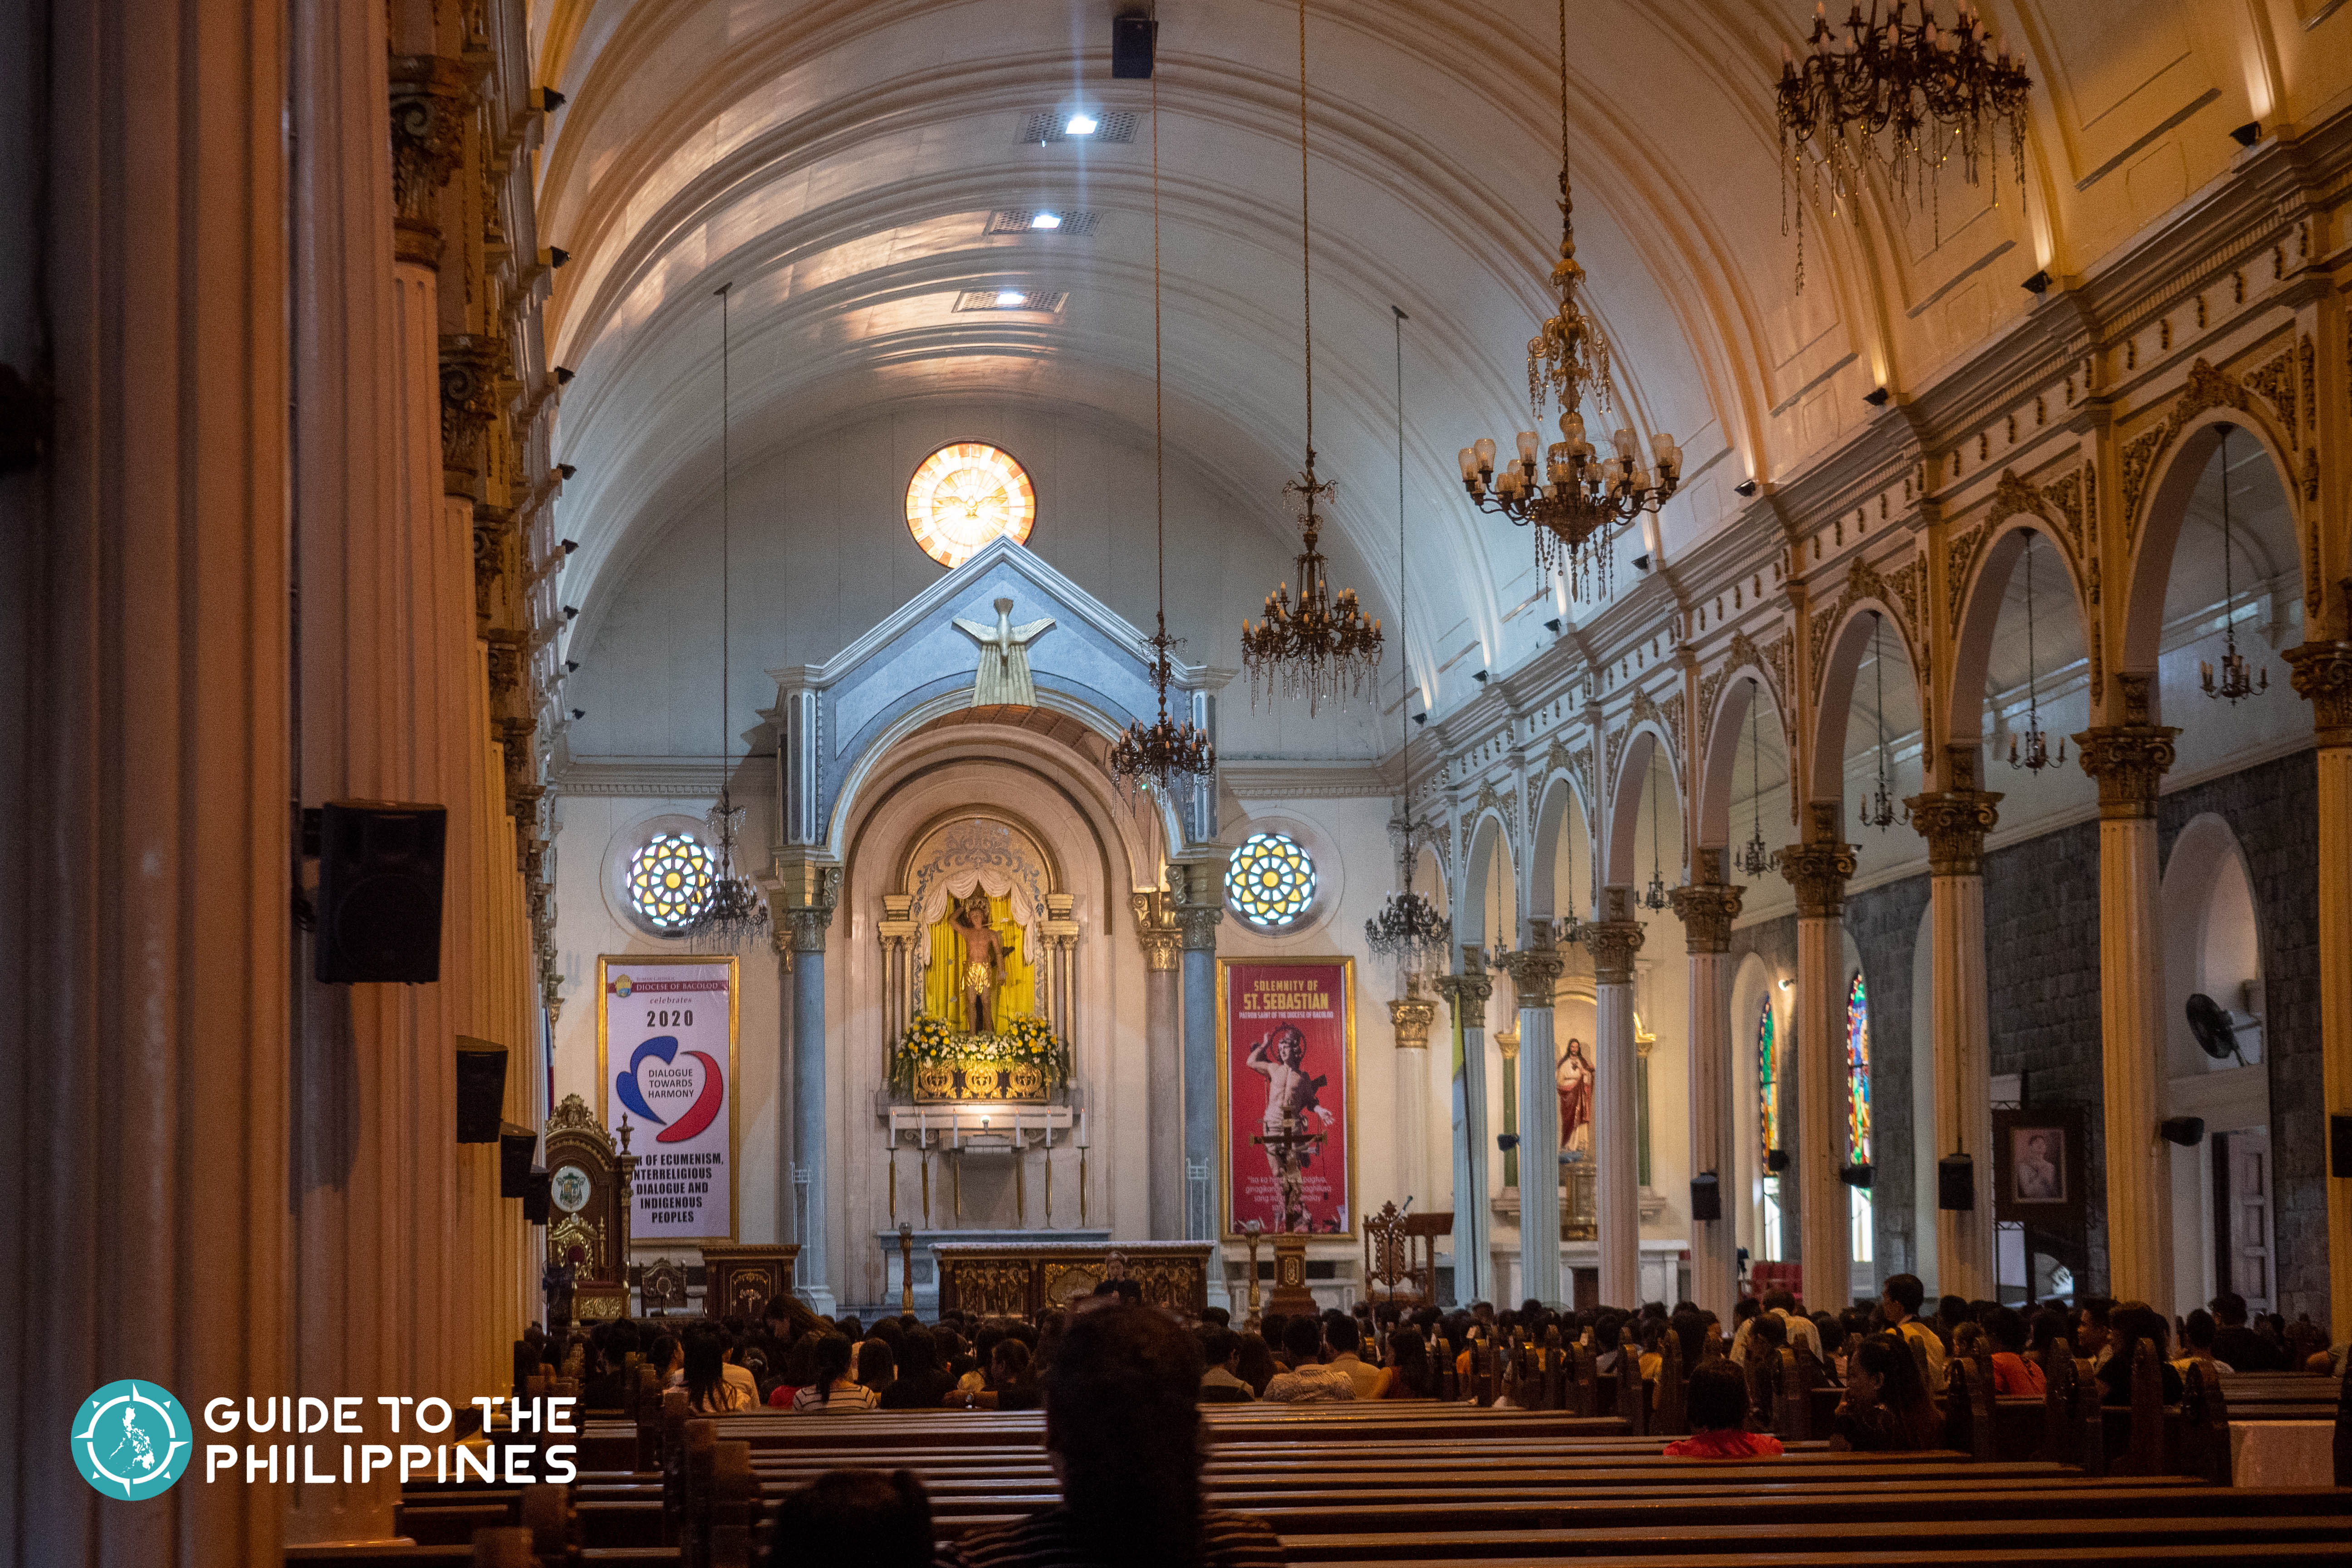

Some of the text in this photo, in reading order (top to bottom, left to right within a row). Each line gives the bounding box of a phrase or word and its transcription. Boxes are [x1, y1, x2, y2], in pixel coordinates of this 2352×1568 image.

[1254, 980, 1318, 991] SOLEMNITY OF
[1244, 992, 1328, 1010] ST. SEBASTIAN
[647, 1010, 693, 1027] 2020
[648, 1068, 693, 1078] DIALOGUE
[649, 1079, 693, 1088] TOWARDS
[648, 1089, 694, 1098] HARMONY
[646, 1155, 657, 1166] OF
[661, 1152, 724, 1166] ECUMENISM,
[634, 1167, 712, 1180] NTERRELIGIOUS
[637, 1181, 709, 1195] DIALOGUE AND
[640, 1196, 702, 1209] INDIGENOUS
[652, 1211, 694, 1223] PEOPLES
